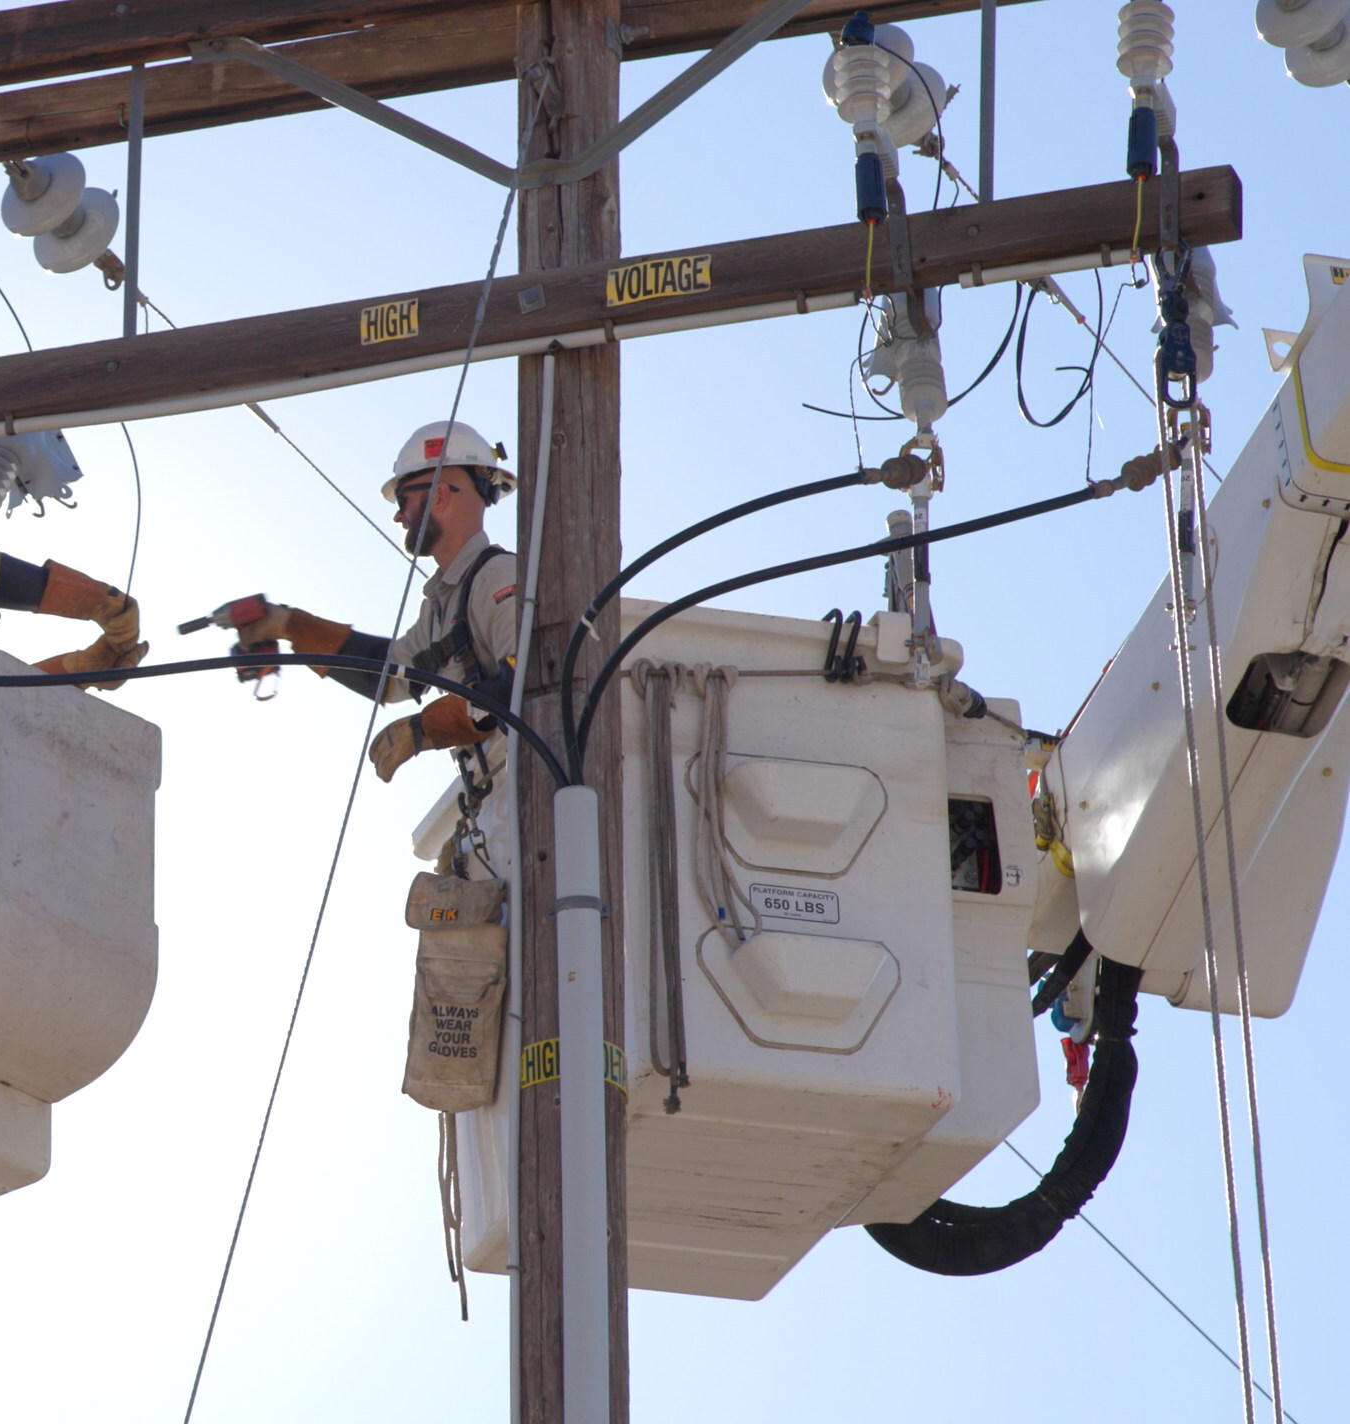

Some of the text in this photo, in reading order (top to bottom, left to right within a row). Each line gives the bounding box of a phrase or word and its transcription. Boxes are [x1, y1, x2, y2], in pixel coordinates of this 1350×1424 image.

[365, 255, 708, 342] HIGH VOLTAGE
[752, 886, 835, 901] PLATFORM CAPACITY
[764, 897, 825, 914] 650 LBS
[431, 1005, 479, 1019] ALWAYS
[435, 1018, 472, 1031] WEAR
[435, 1030, 470, 1044] YOUR
[428, 1041, 477, 1058] GLOVES
